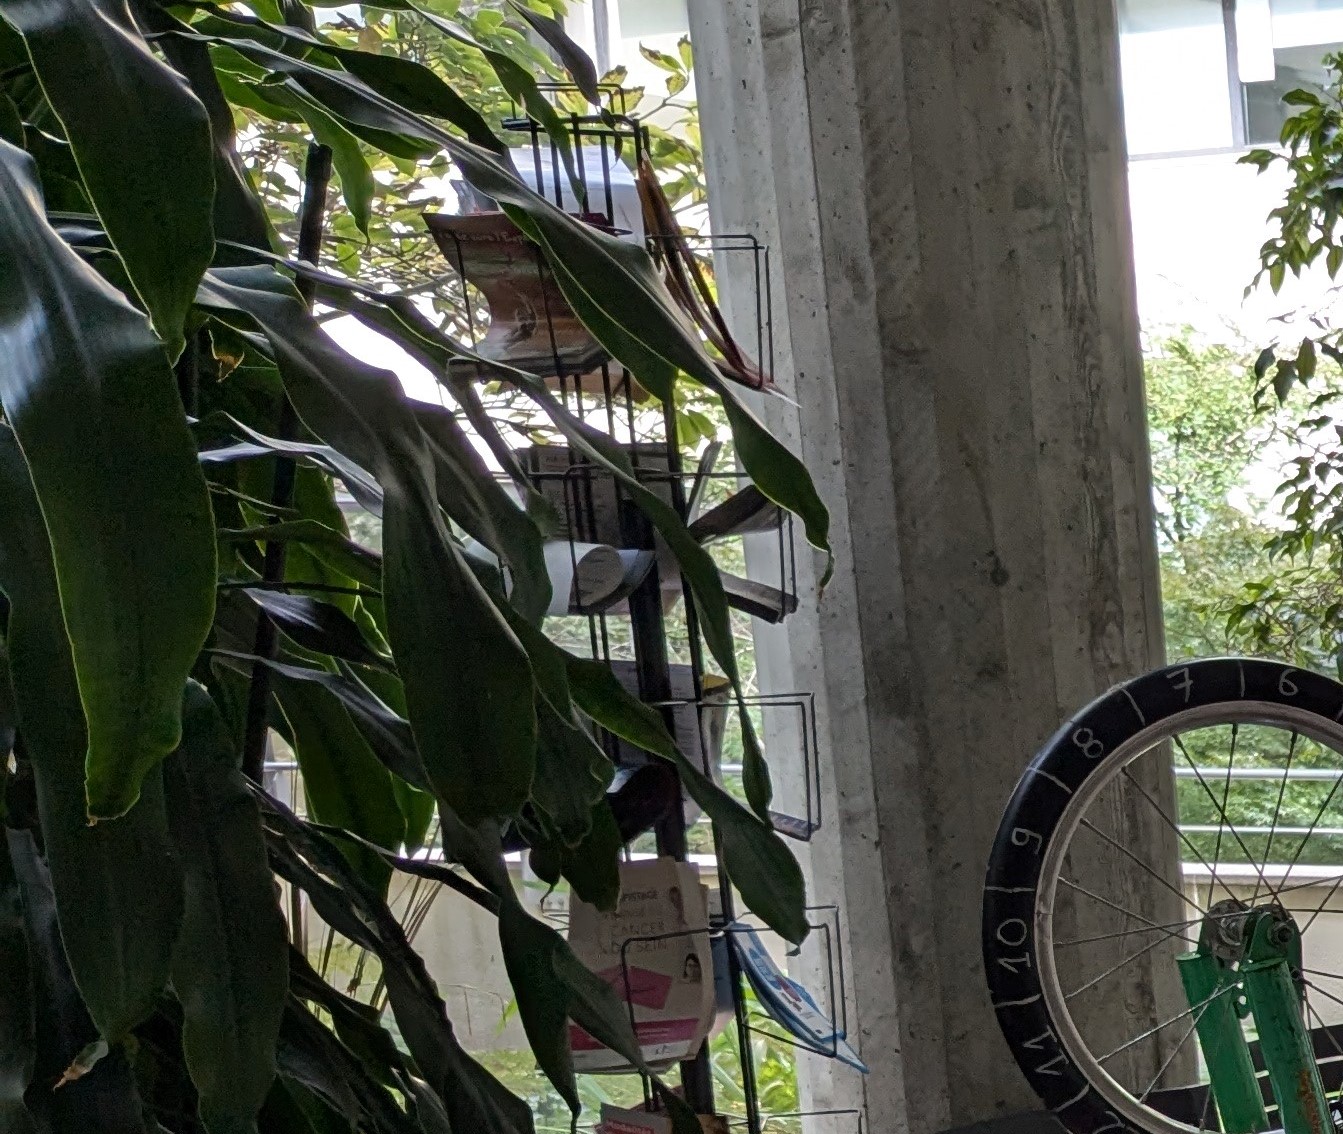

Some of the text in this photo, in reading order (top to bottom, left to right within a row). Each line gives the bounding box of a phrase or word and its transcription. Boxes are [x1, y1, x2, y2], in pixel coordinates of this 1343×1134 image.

[1166, 667, 1193, 703] 7
[1279, 668, 1299, 696] 6
[1072, 727, 1104, 758] 8
[1011, 827, 1043, 855] 9
[996, 918, 1031, 974] 10
[1022, 1024, 1070, 1076] 11
